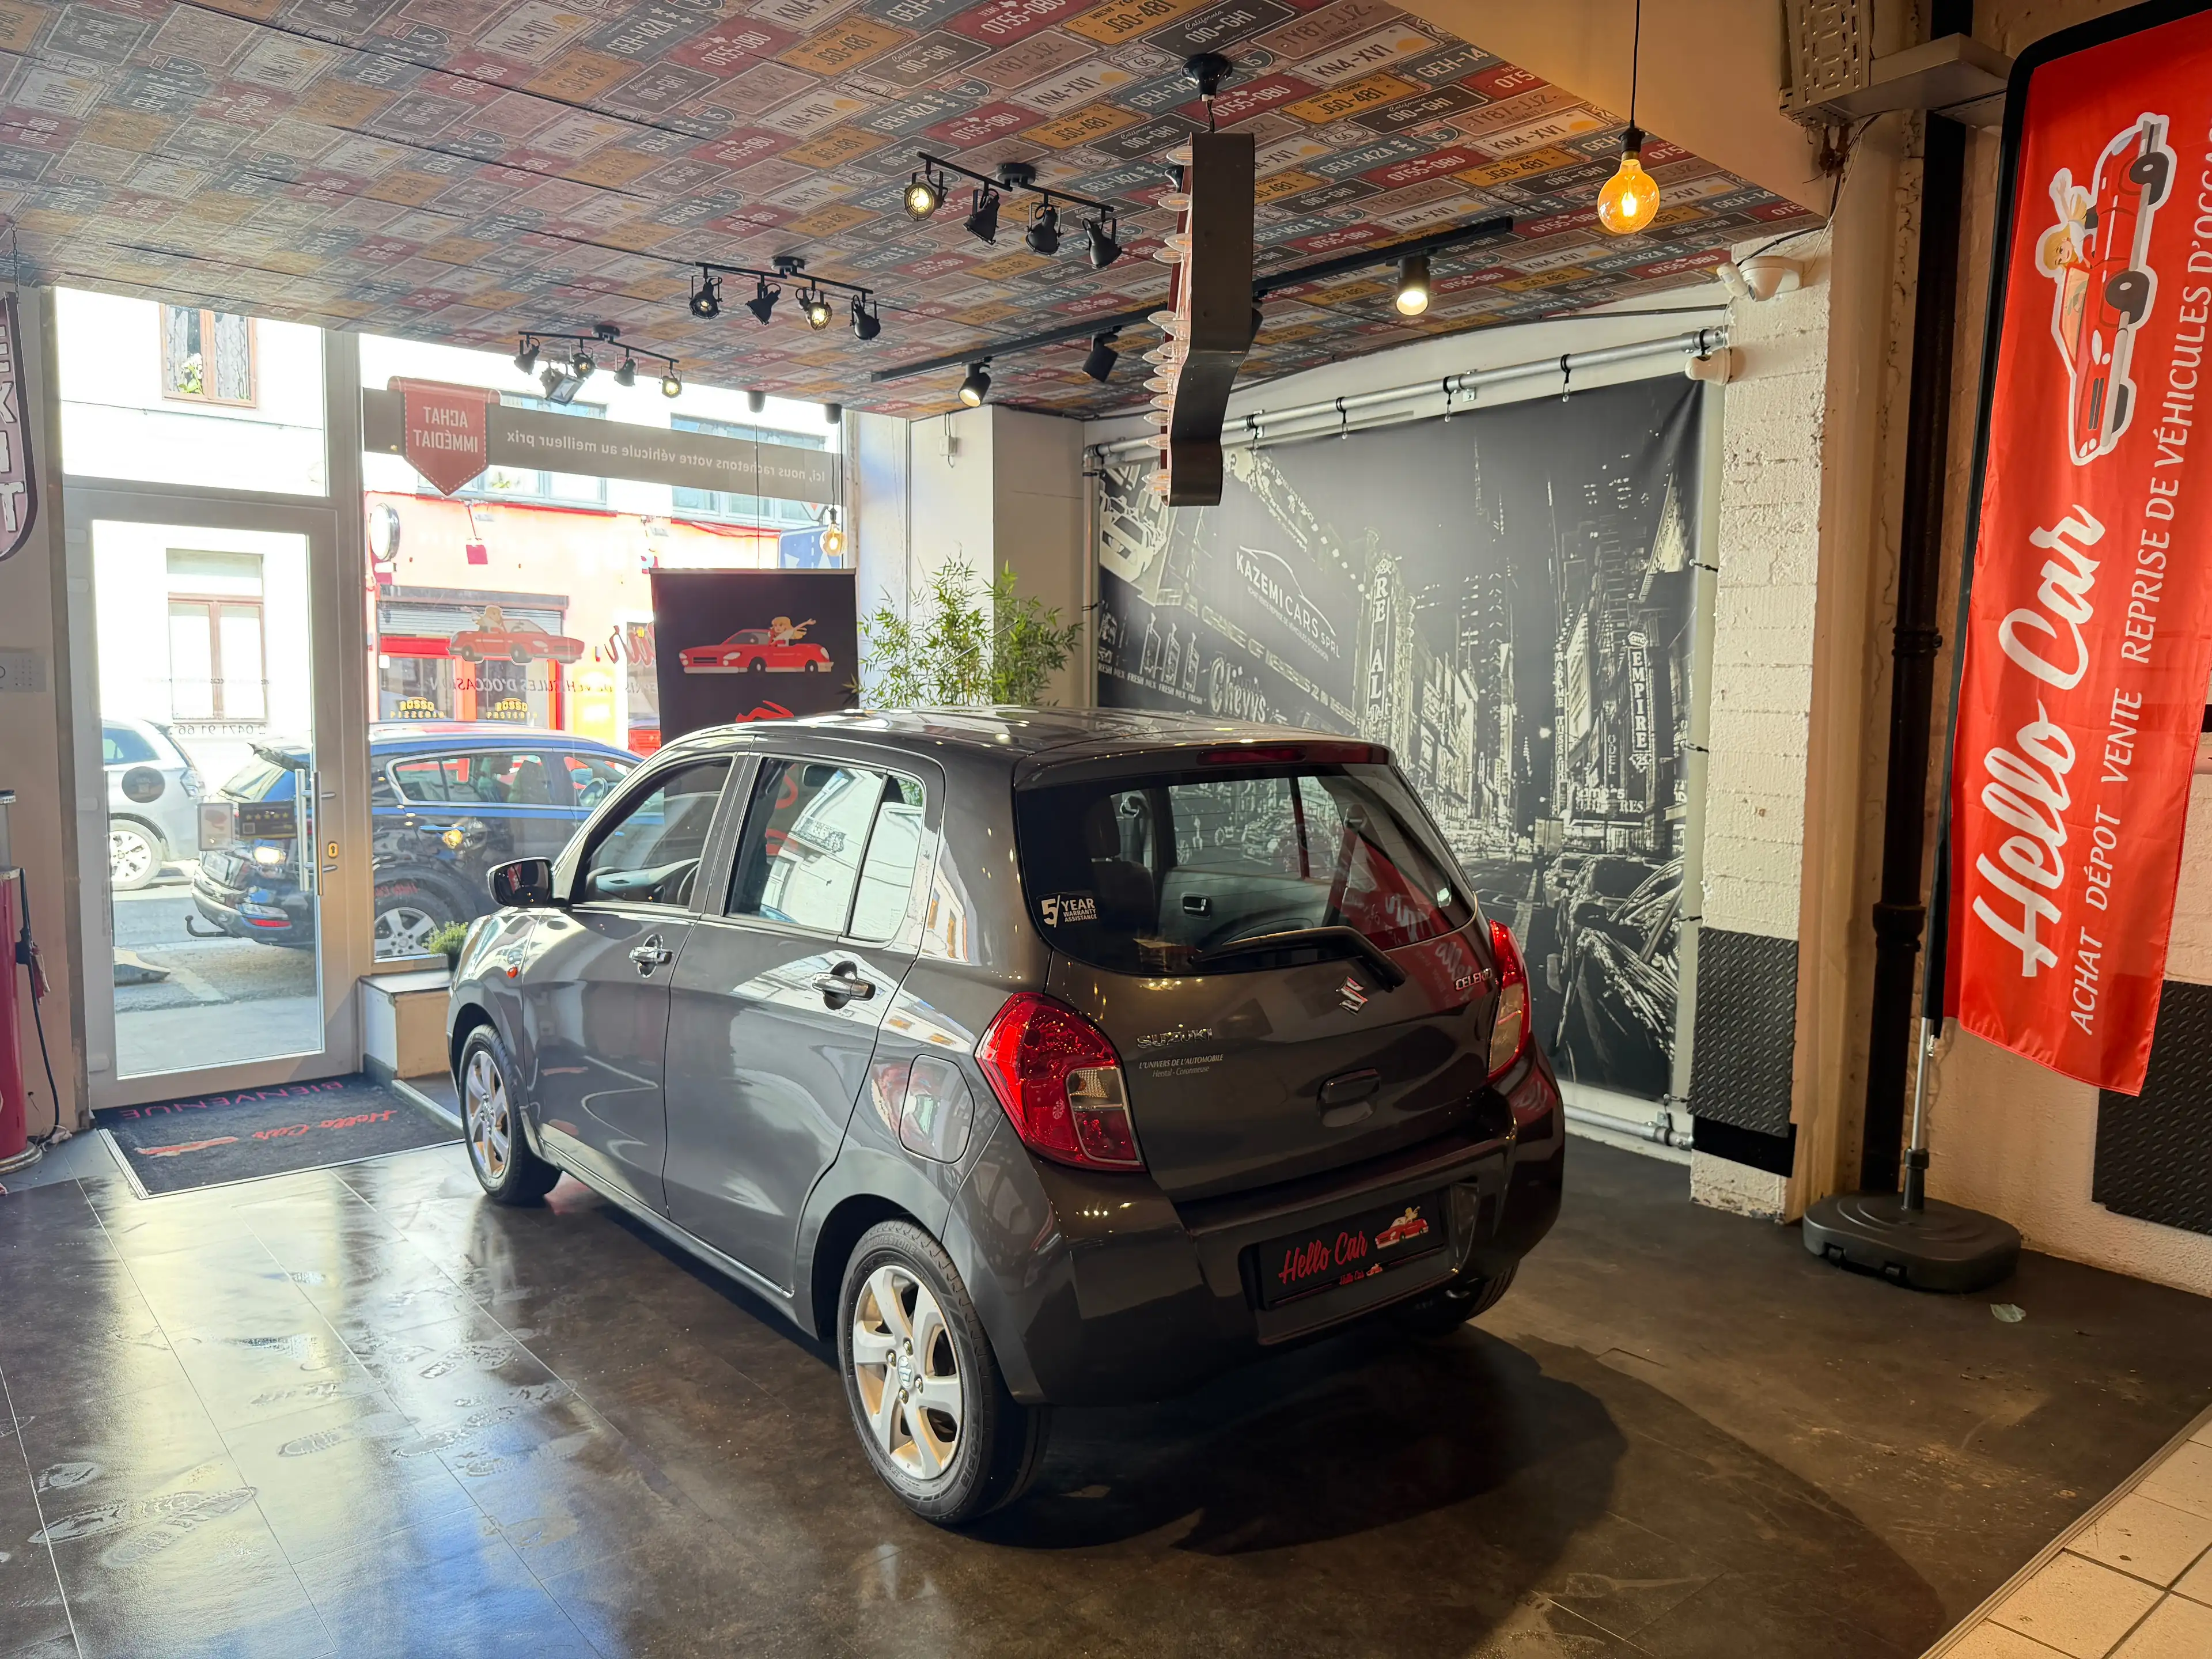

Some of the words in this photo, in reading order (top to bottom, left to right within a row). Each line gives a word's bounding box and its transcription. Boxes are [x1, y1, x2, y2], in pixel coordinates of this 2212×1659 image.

[606, 17, 676, 55] GEH-142A
[870, 102, 940, 131] GEH-142A
[1319, 147, 1396, 172] GEH-142A
[1080, 172, 1146, 194] GEH-142A
[2150, 286, 2211, 468] VÉHICULES
[2145, 478, 2180, 522] DE
[1236, 551, 1283, 607] KAZEMI
[1285, 596, 1319, 639] CARS
[1320, 631, 1341, 659] SPRL
[1998, 504, 2106, 690] Car
[2121, 529, 2170, 664] REPRISE
[1631, 651, 1647, 748] EMPIRE
[2101, 687, 2142, 782] VENTE
[1973, 699, 2075, 977] Hello
[2083, 804, 2121, 911] DÉPOT
[1061, 897, 1095, 912] YEAR
[1063, 908, 1096, 918] WARRANTY
[1064, 913, 1097, 923] ASSISTANCE
[2070, 926, 2105, 1035] ACHAT
[1137, 1027, 1213, 1048] SUZUKI
[1138, 1059, 1170, 1069] L'UNIVERS
[1171, 1058, 1180, 1067] DE
[1180, 1053, 1224, 1066] L'AUTOMOBILE
[119, 1081, 344, 1120] BIENVENUE
[1278, 1239, 1332, 1285] Hello
[1334, 1230, 1369, 1266] Car
